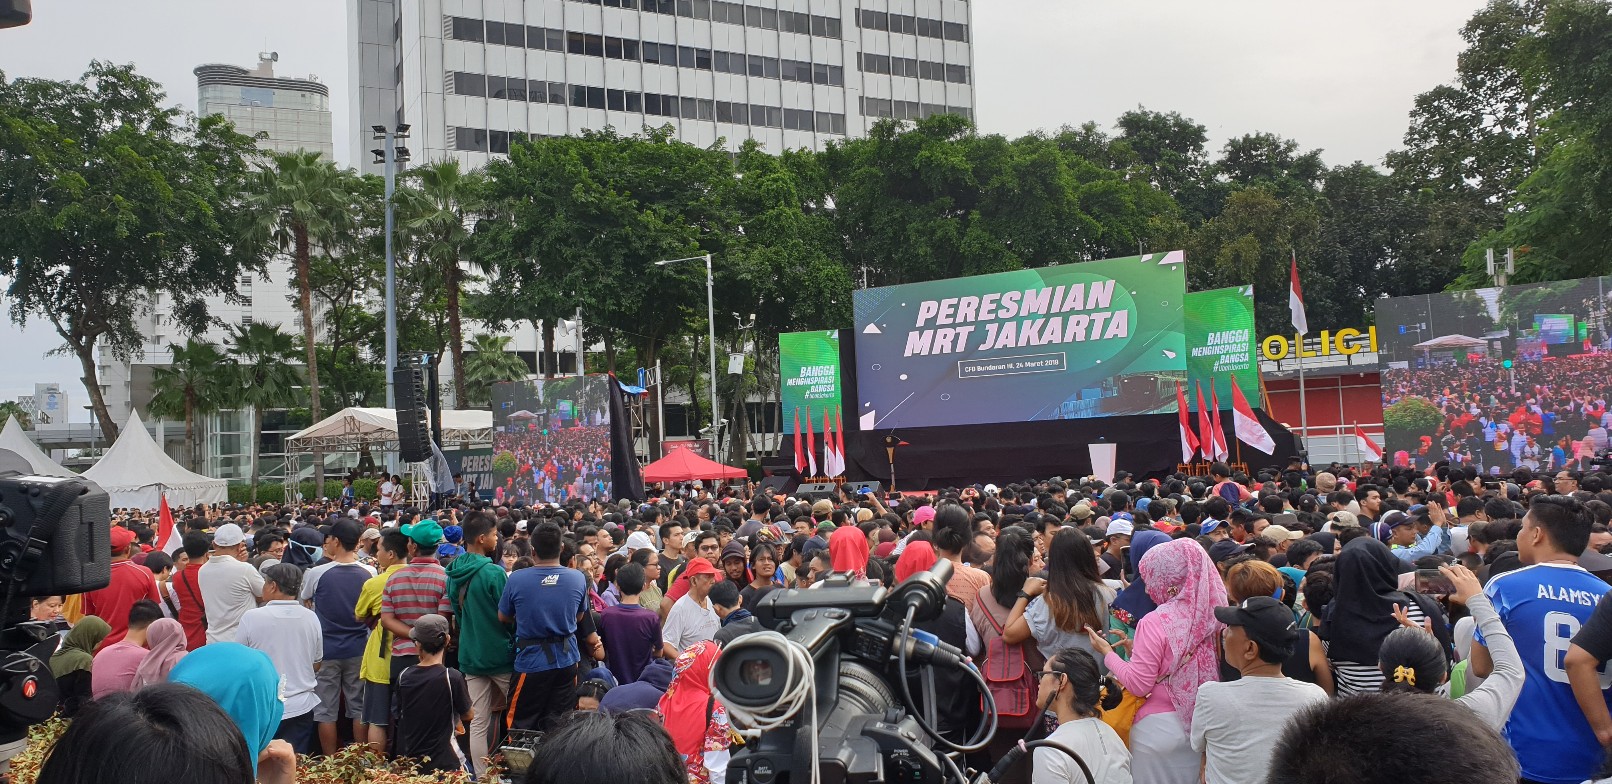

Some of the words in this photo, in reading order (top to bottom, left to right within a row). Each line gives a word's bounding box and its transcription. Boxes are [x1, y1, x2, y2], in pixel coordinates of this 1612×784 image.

[915, 279, 1116, 328] PERESMIAN
[903, 325, 975, 357] MRT
[978, 309, 1129, 351] JAKARTA
[1207, 328, 1249, 346] BANGGA
[1191, 342, 1249, 357] MENGINSPIRASI
[976, 363, 1006, 372] Bundaran
[1016, 361, 1024, 369] 24
[1024, 358, 1044, 368] Maret
[1219, 353, 1249, 364] BANGSA
[800, 364, 835, 378] BANGGA
[786, 376, 835, 386] MENGINSPIRASI
[810, 384, 835, 393] BANGSA
[1537, 584, 1605, 607] ALAMSY
